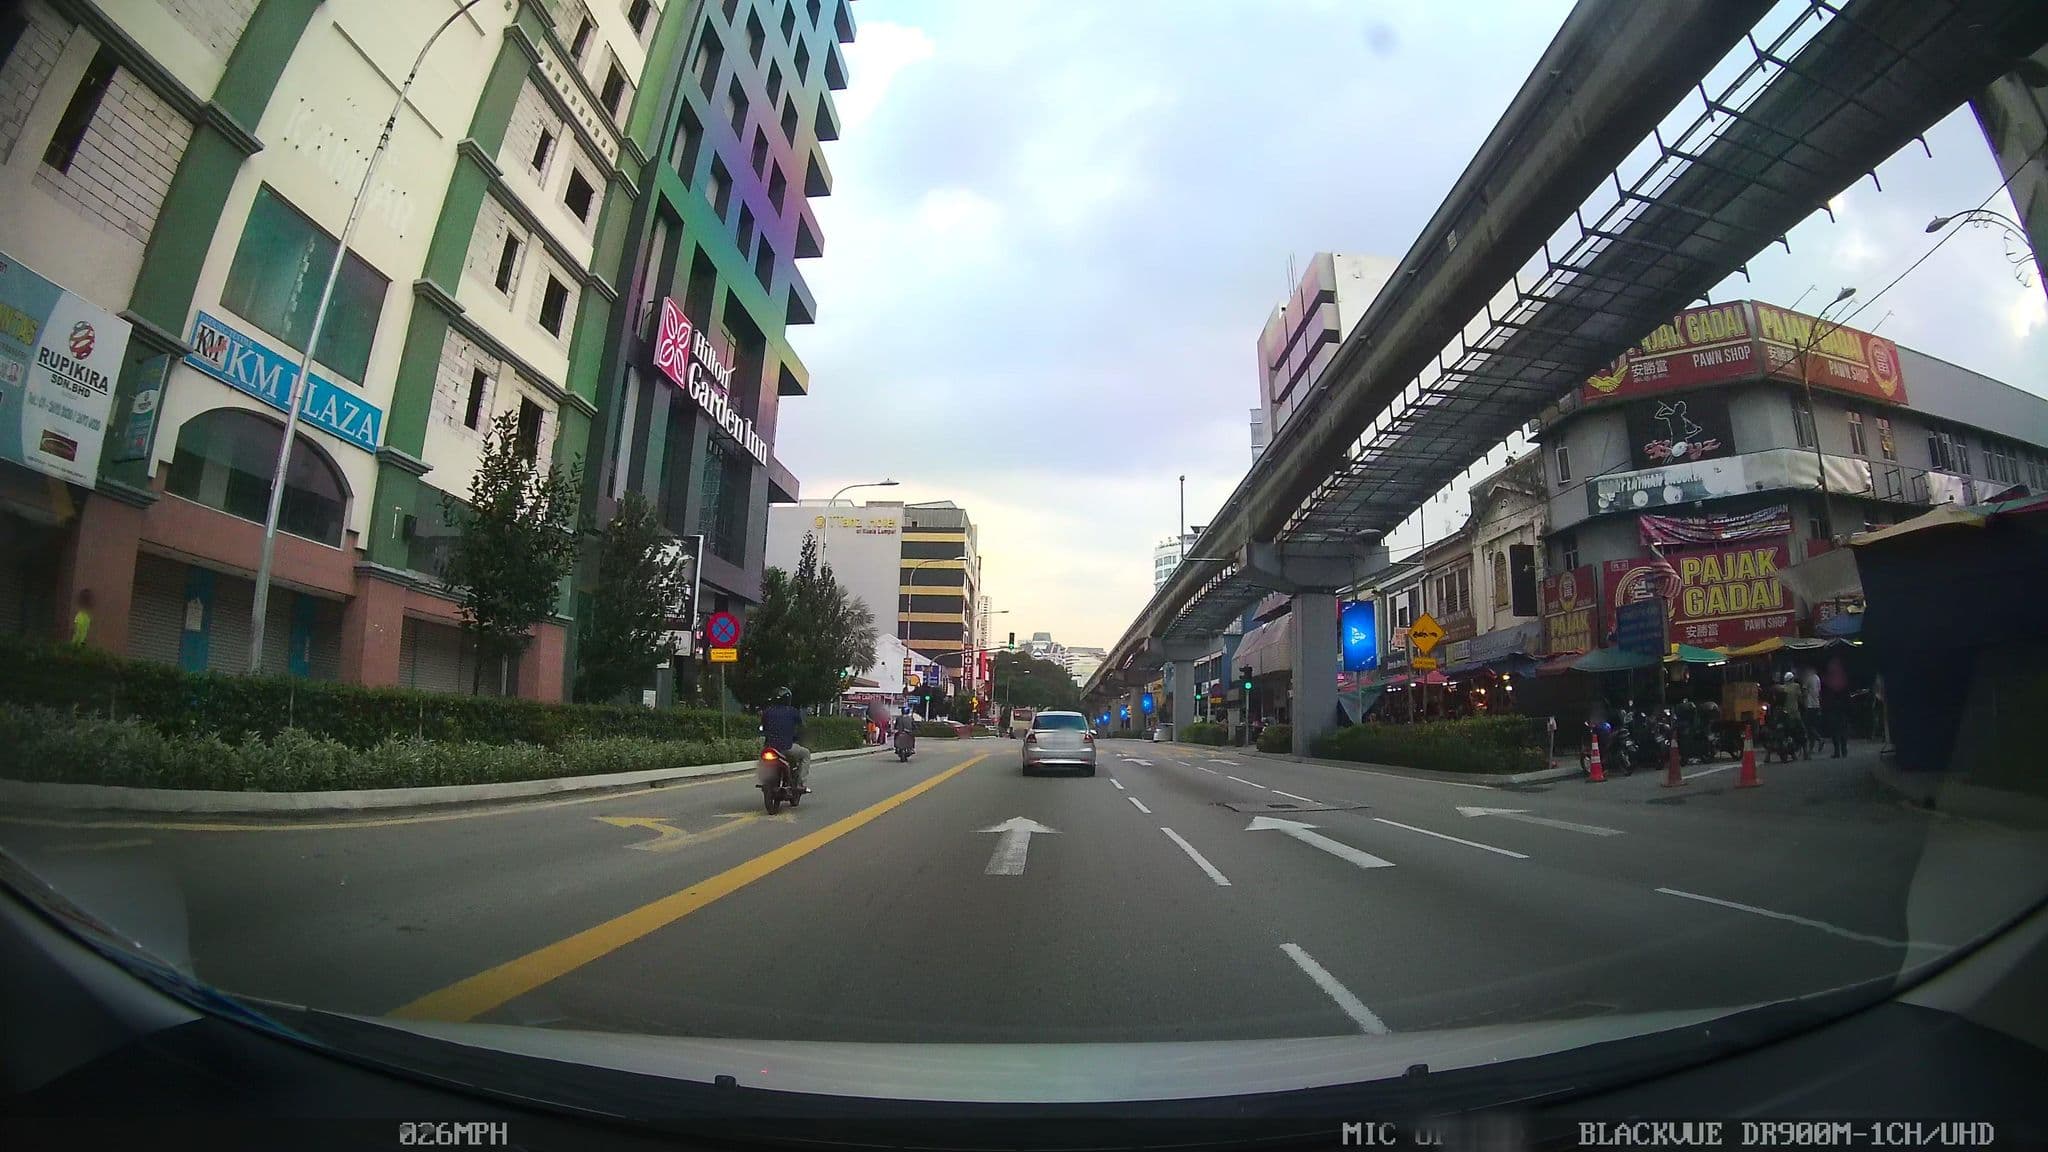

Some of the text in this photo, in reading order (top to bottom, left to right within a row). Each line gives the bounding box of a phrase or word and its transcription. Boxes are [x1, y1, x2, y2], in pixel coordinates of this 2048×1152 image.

[1686, 304, 1747, 344] GADAI
[38, 346, 109, 393] RUPIKIRA
[225, 341, 284, 399] KM
[693, 329, 734, 389] Hilton
[1692, 345, 1751, 368] PAWN SHOP
[1828, 360, 1851, 379] PAWN
[688, 362, 768, 467] Garden Inn
[1681, 547, 1779, 586] PAJAK
[1683, 579, 1783, 617] GADAI
[1744, 616, 1788, 631] PAWN SHOP
